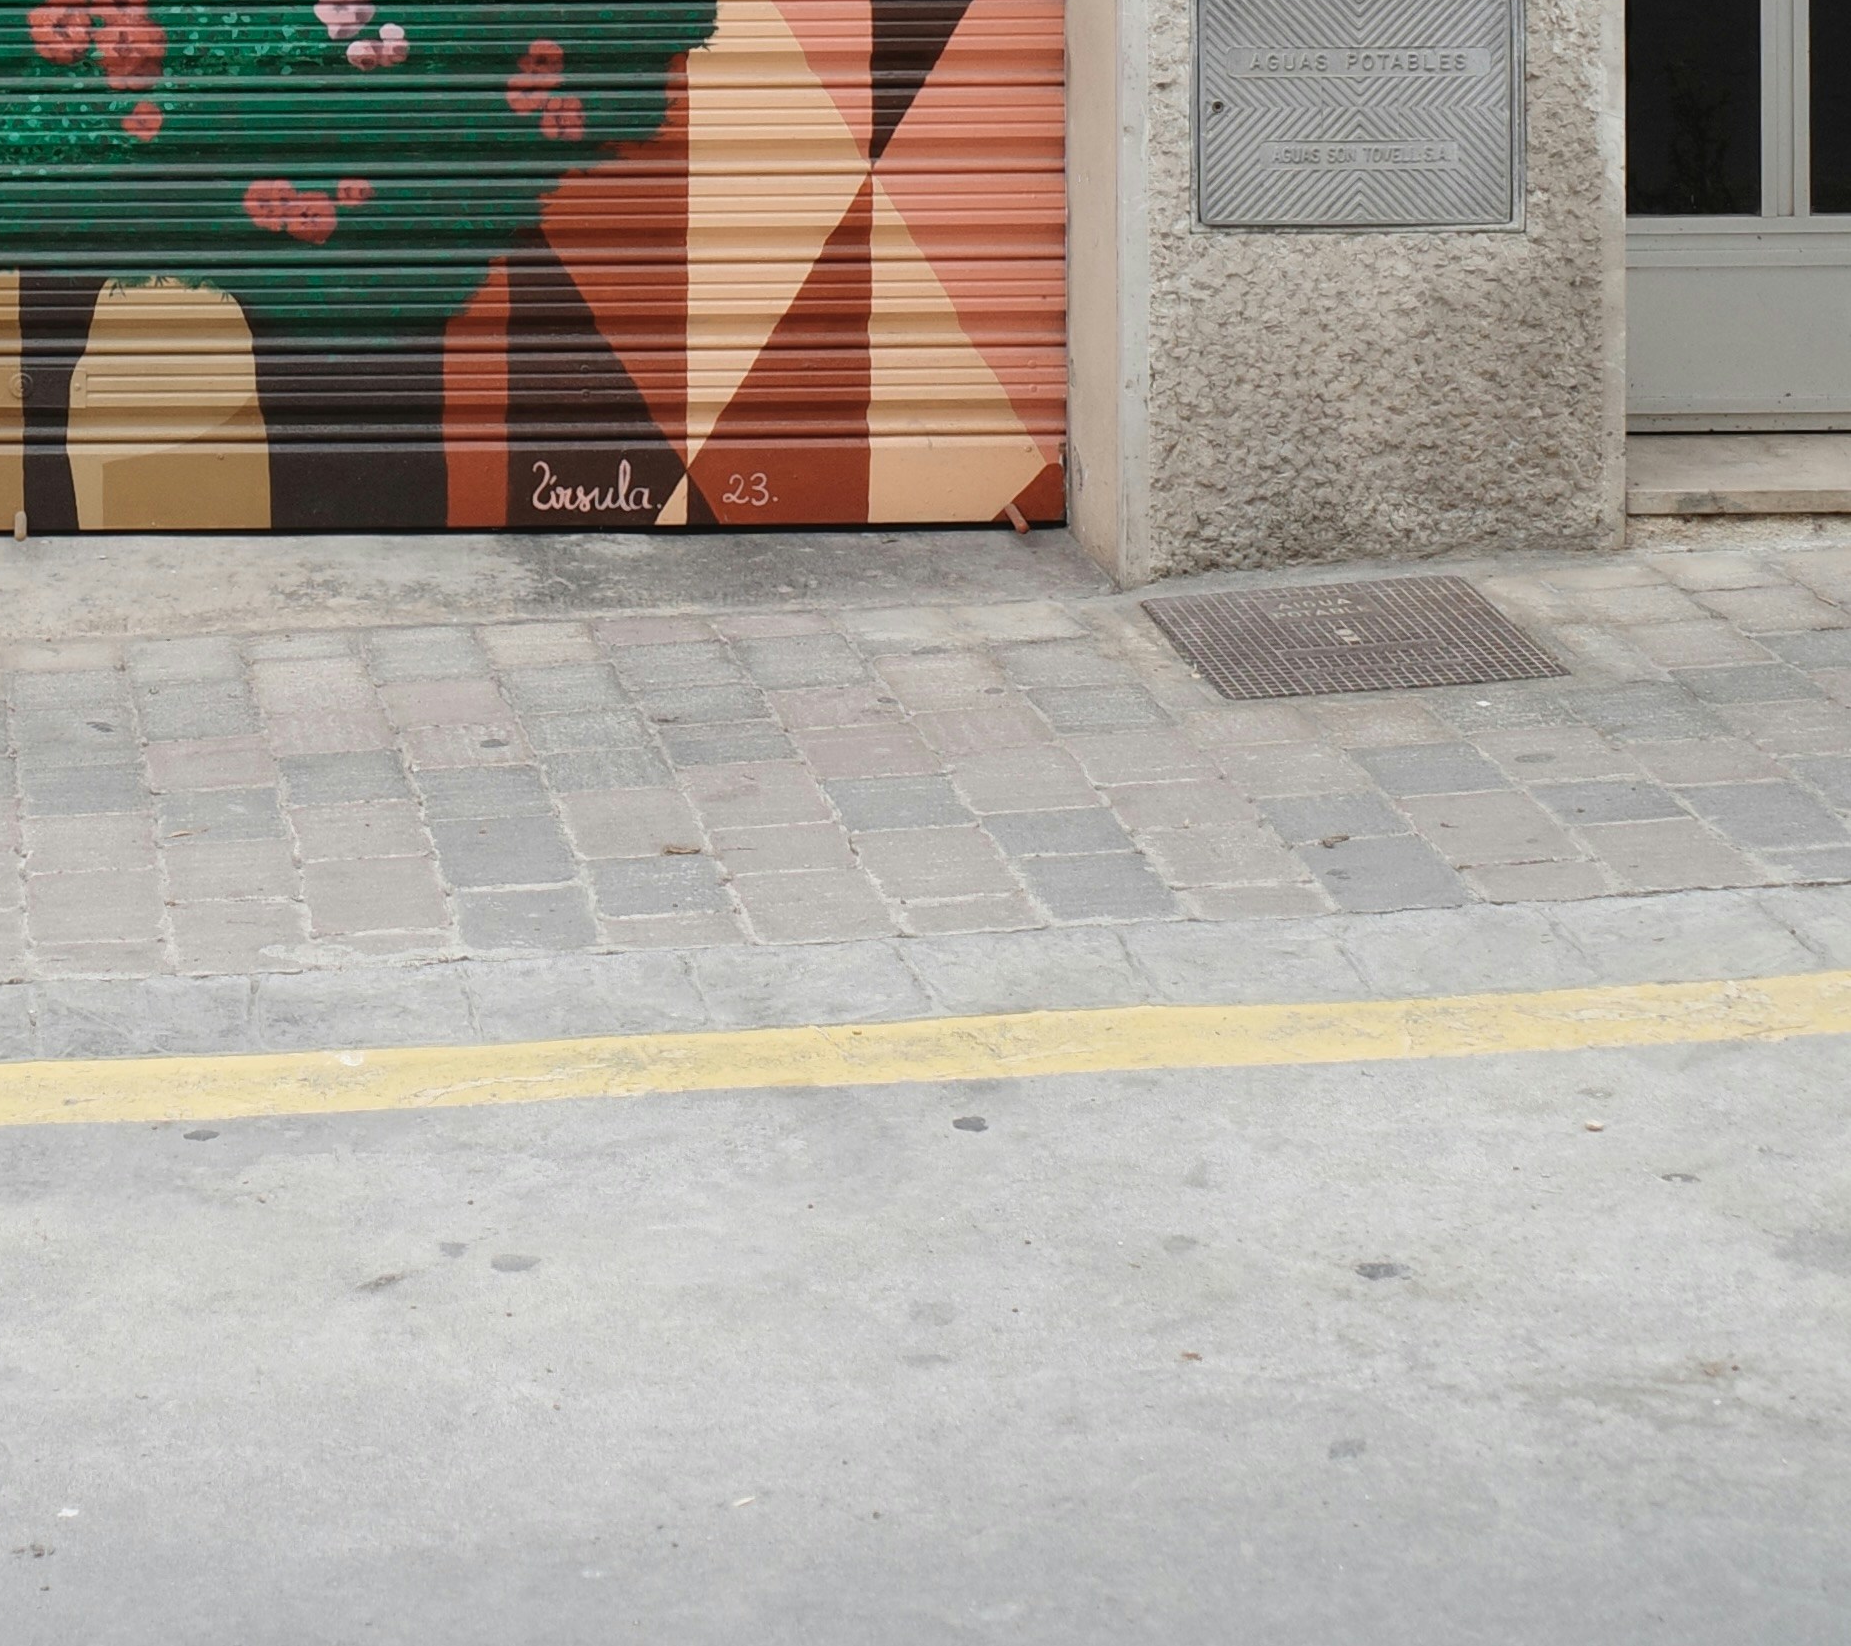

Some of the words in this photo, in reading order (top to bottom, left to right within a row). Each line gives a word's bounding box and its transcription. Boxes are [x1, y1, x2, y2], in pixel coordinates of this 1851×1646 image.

[1249, 53, 1330, 72] AGUAS
[1347, 53, 1470, 72] POTABLES
[1271, 147, 1321, 164] AGUAS
[1327, 147, 1357, 163] SON
[1270, 605, 1373, 620] POTABLE
